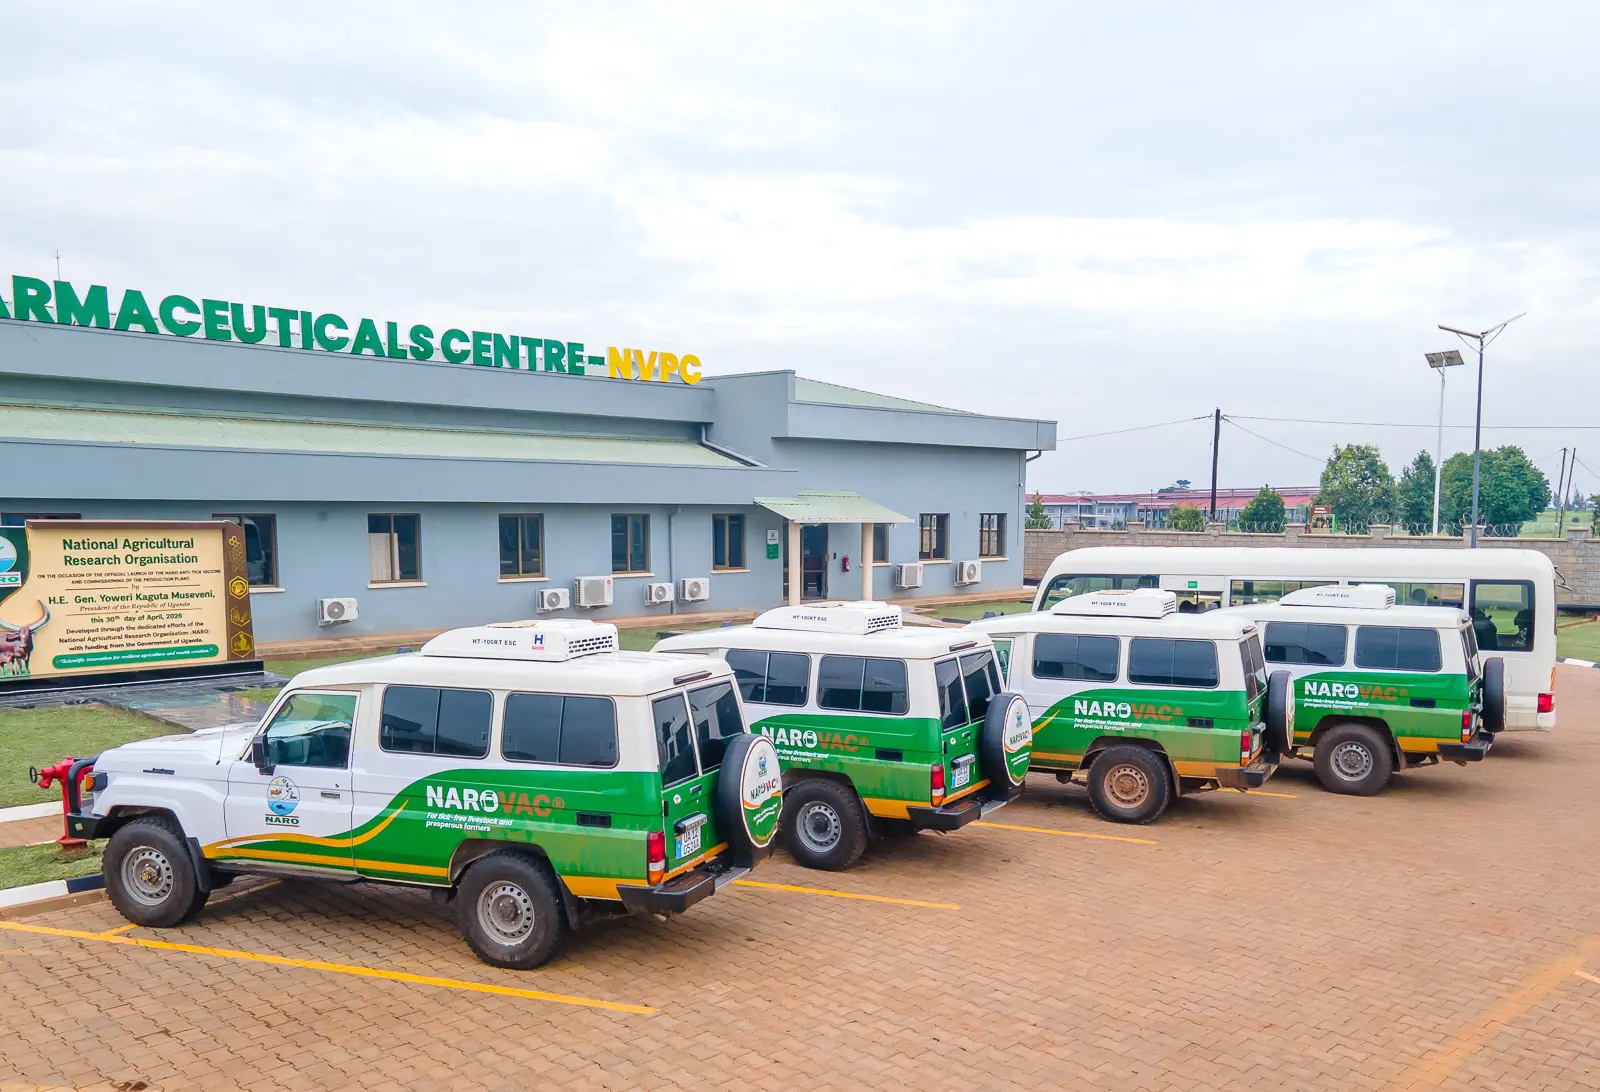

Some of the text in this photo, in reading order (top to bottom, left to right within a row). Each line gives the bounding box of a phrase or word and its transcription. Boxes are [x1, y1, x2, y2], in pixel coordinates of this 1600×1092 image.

[0, 275, 434, 361] RMACEUTICALS
[62, 538, 194, 552] National Agricultural
[64, 553, 198, 566] Research Organisation
[49, 590, 215, 604] H.E. Gen. Yoweri Kaguta Museveni,
[265, 816, 300, 825] NARO
[426, 821, 463, 830] prosperous
[438, 813, 467, 822] tick-free
[468, 816, 498, 825] livestock
